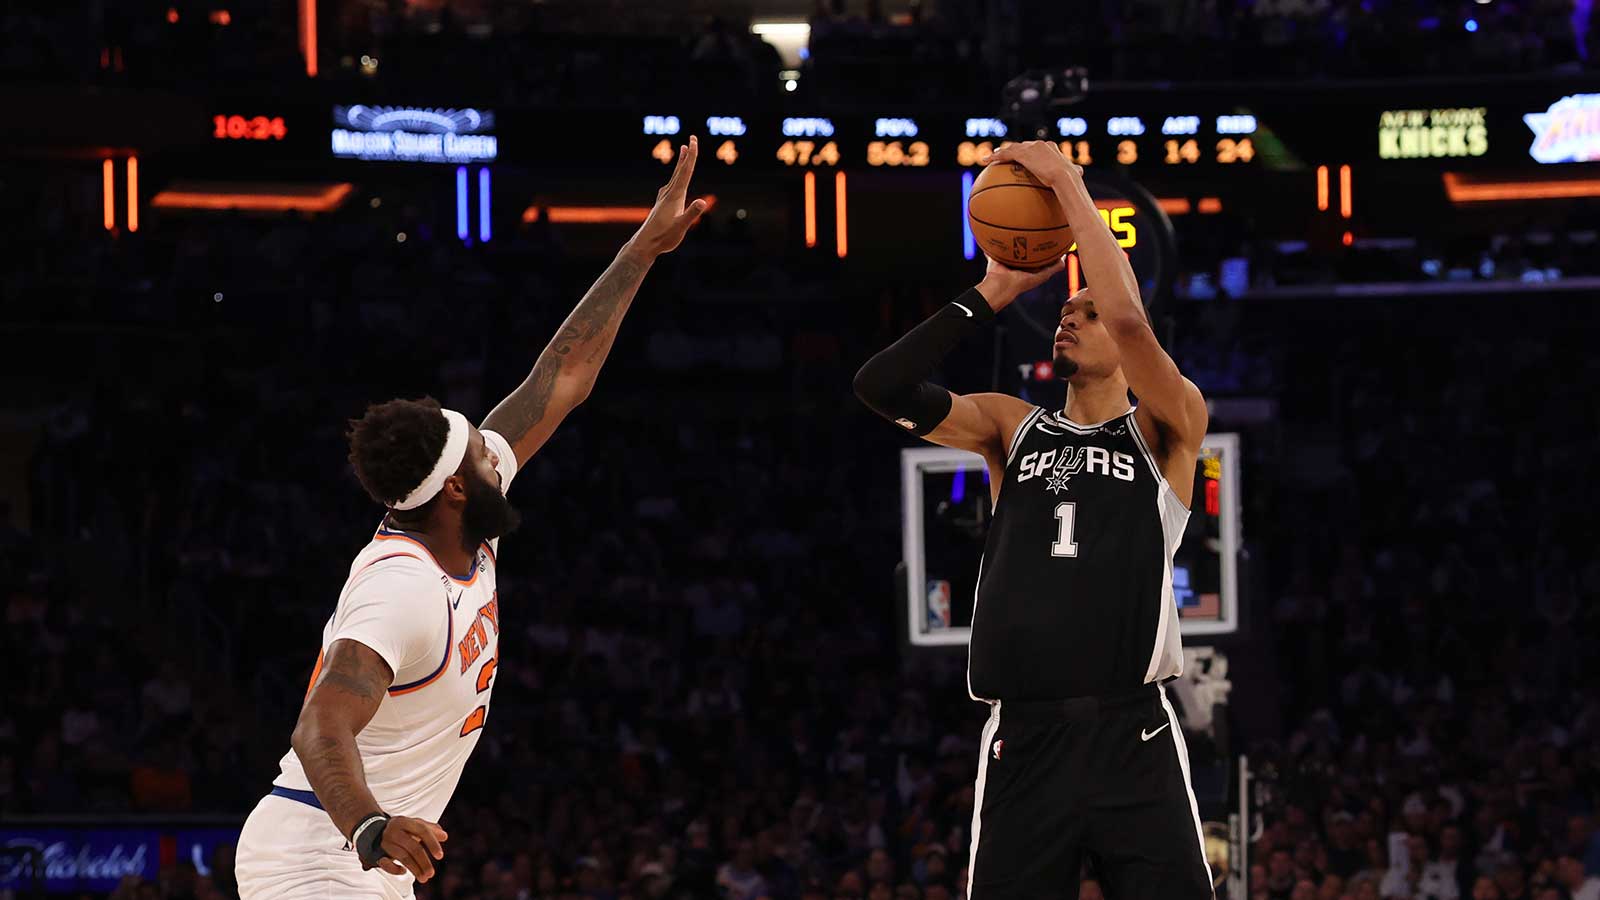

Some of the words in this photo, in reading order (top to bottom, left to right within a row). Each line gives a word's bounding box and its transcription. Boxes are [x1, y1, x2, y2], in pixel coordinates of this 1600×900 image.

[214, 115, 287, 140] 10:24
[1057, 118, 1088, 136] TO
[1107, 117, 1146, 135] STL
[1162, 116, 1200, 134] AST
[1379, 110, 1429, 126] NEW
[1430, 107, 1487, 126] YORK
[652, 139, 674, 164] 4
[716, 140, 738, 165] 4
[776, 141, 840, 166] 47.4
[867, 142, 930, 166] 56.2
[1117, 140, 1138, 164] 3
[1165, 139, 1201, 164] 14
[1216, 138, 1256, 163] 24
[1378, 124, 1489, 160] KNICKS
[1017, 446, 1136, 493] SPURS
[1051, 501, 1079, 558] 1
[458, 611, 488, 677] NEW
